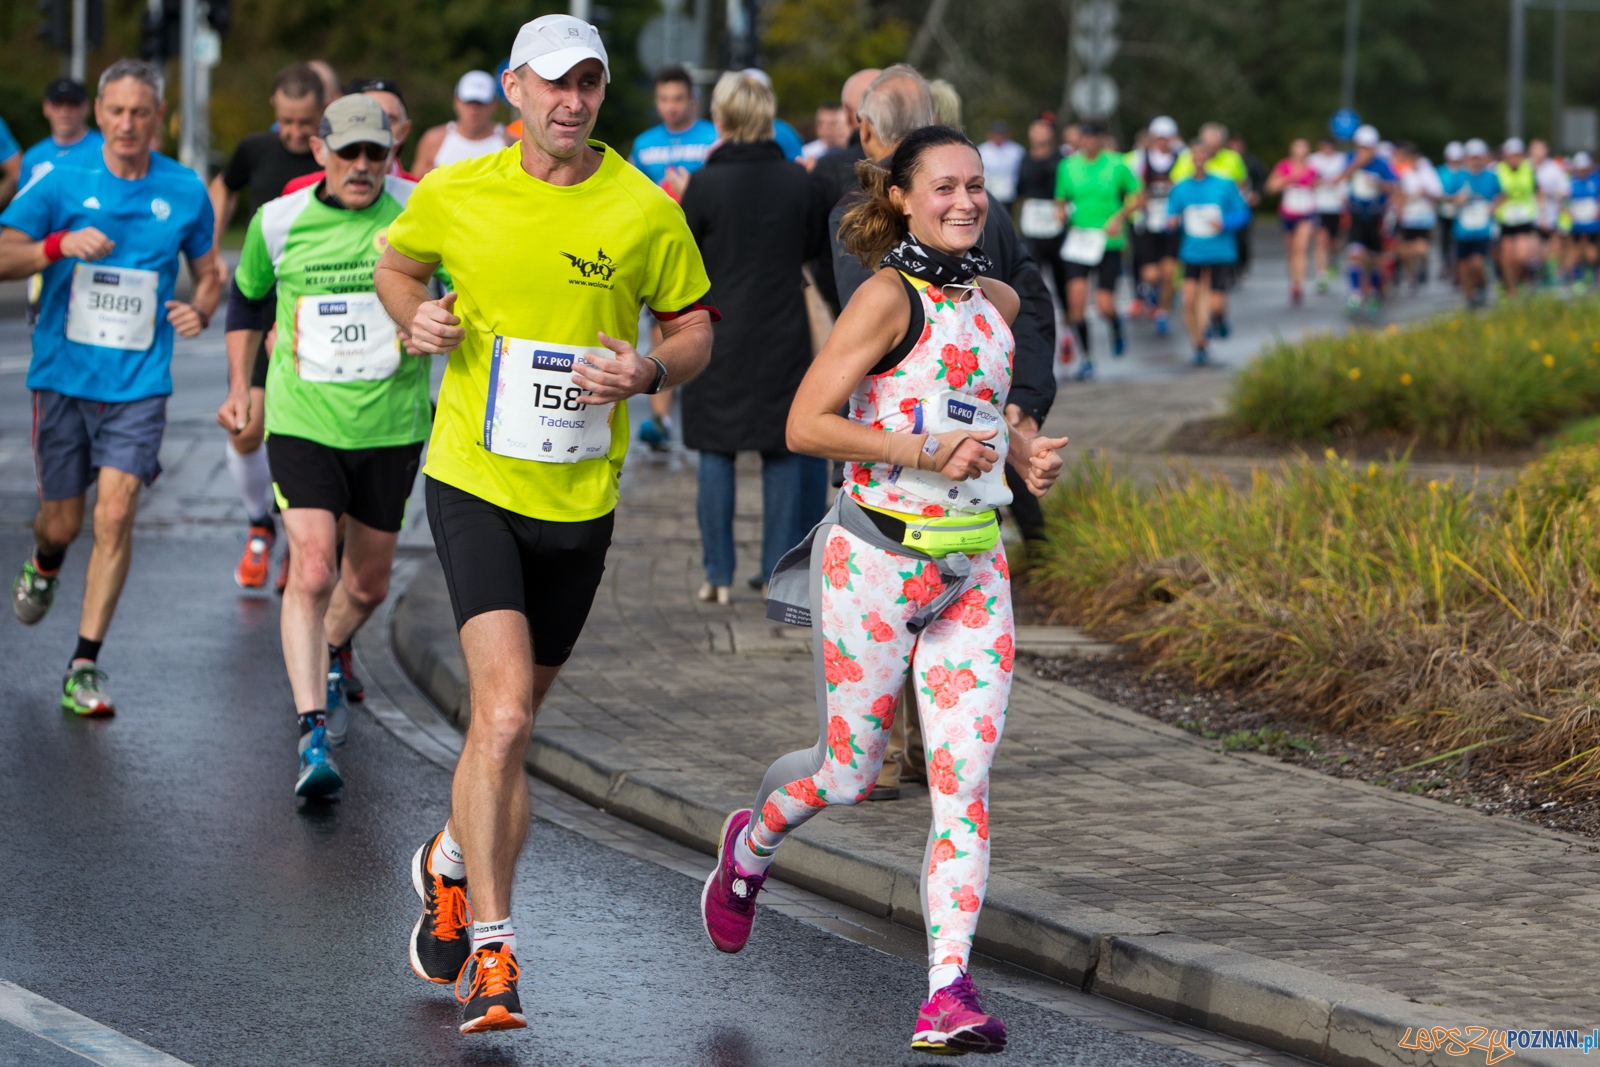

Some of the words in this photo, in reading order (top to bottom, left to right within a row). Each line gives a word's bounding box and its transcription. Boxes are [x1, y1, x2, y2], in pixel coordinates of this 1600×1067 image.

[305, 276, 335, 286] KLUB
[568, 279, 615, 290] www.wolow.pl
[87, 291, 142, 315] 3889
[330, 324, 366, 343] 201
[538, 415, 586, 429] Tadeusz
